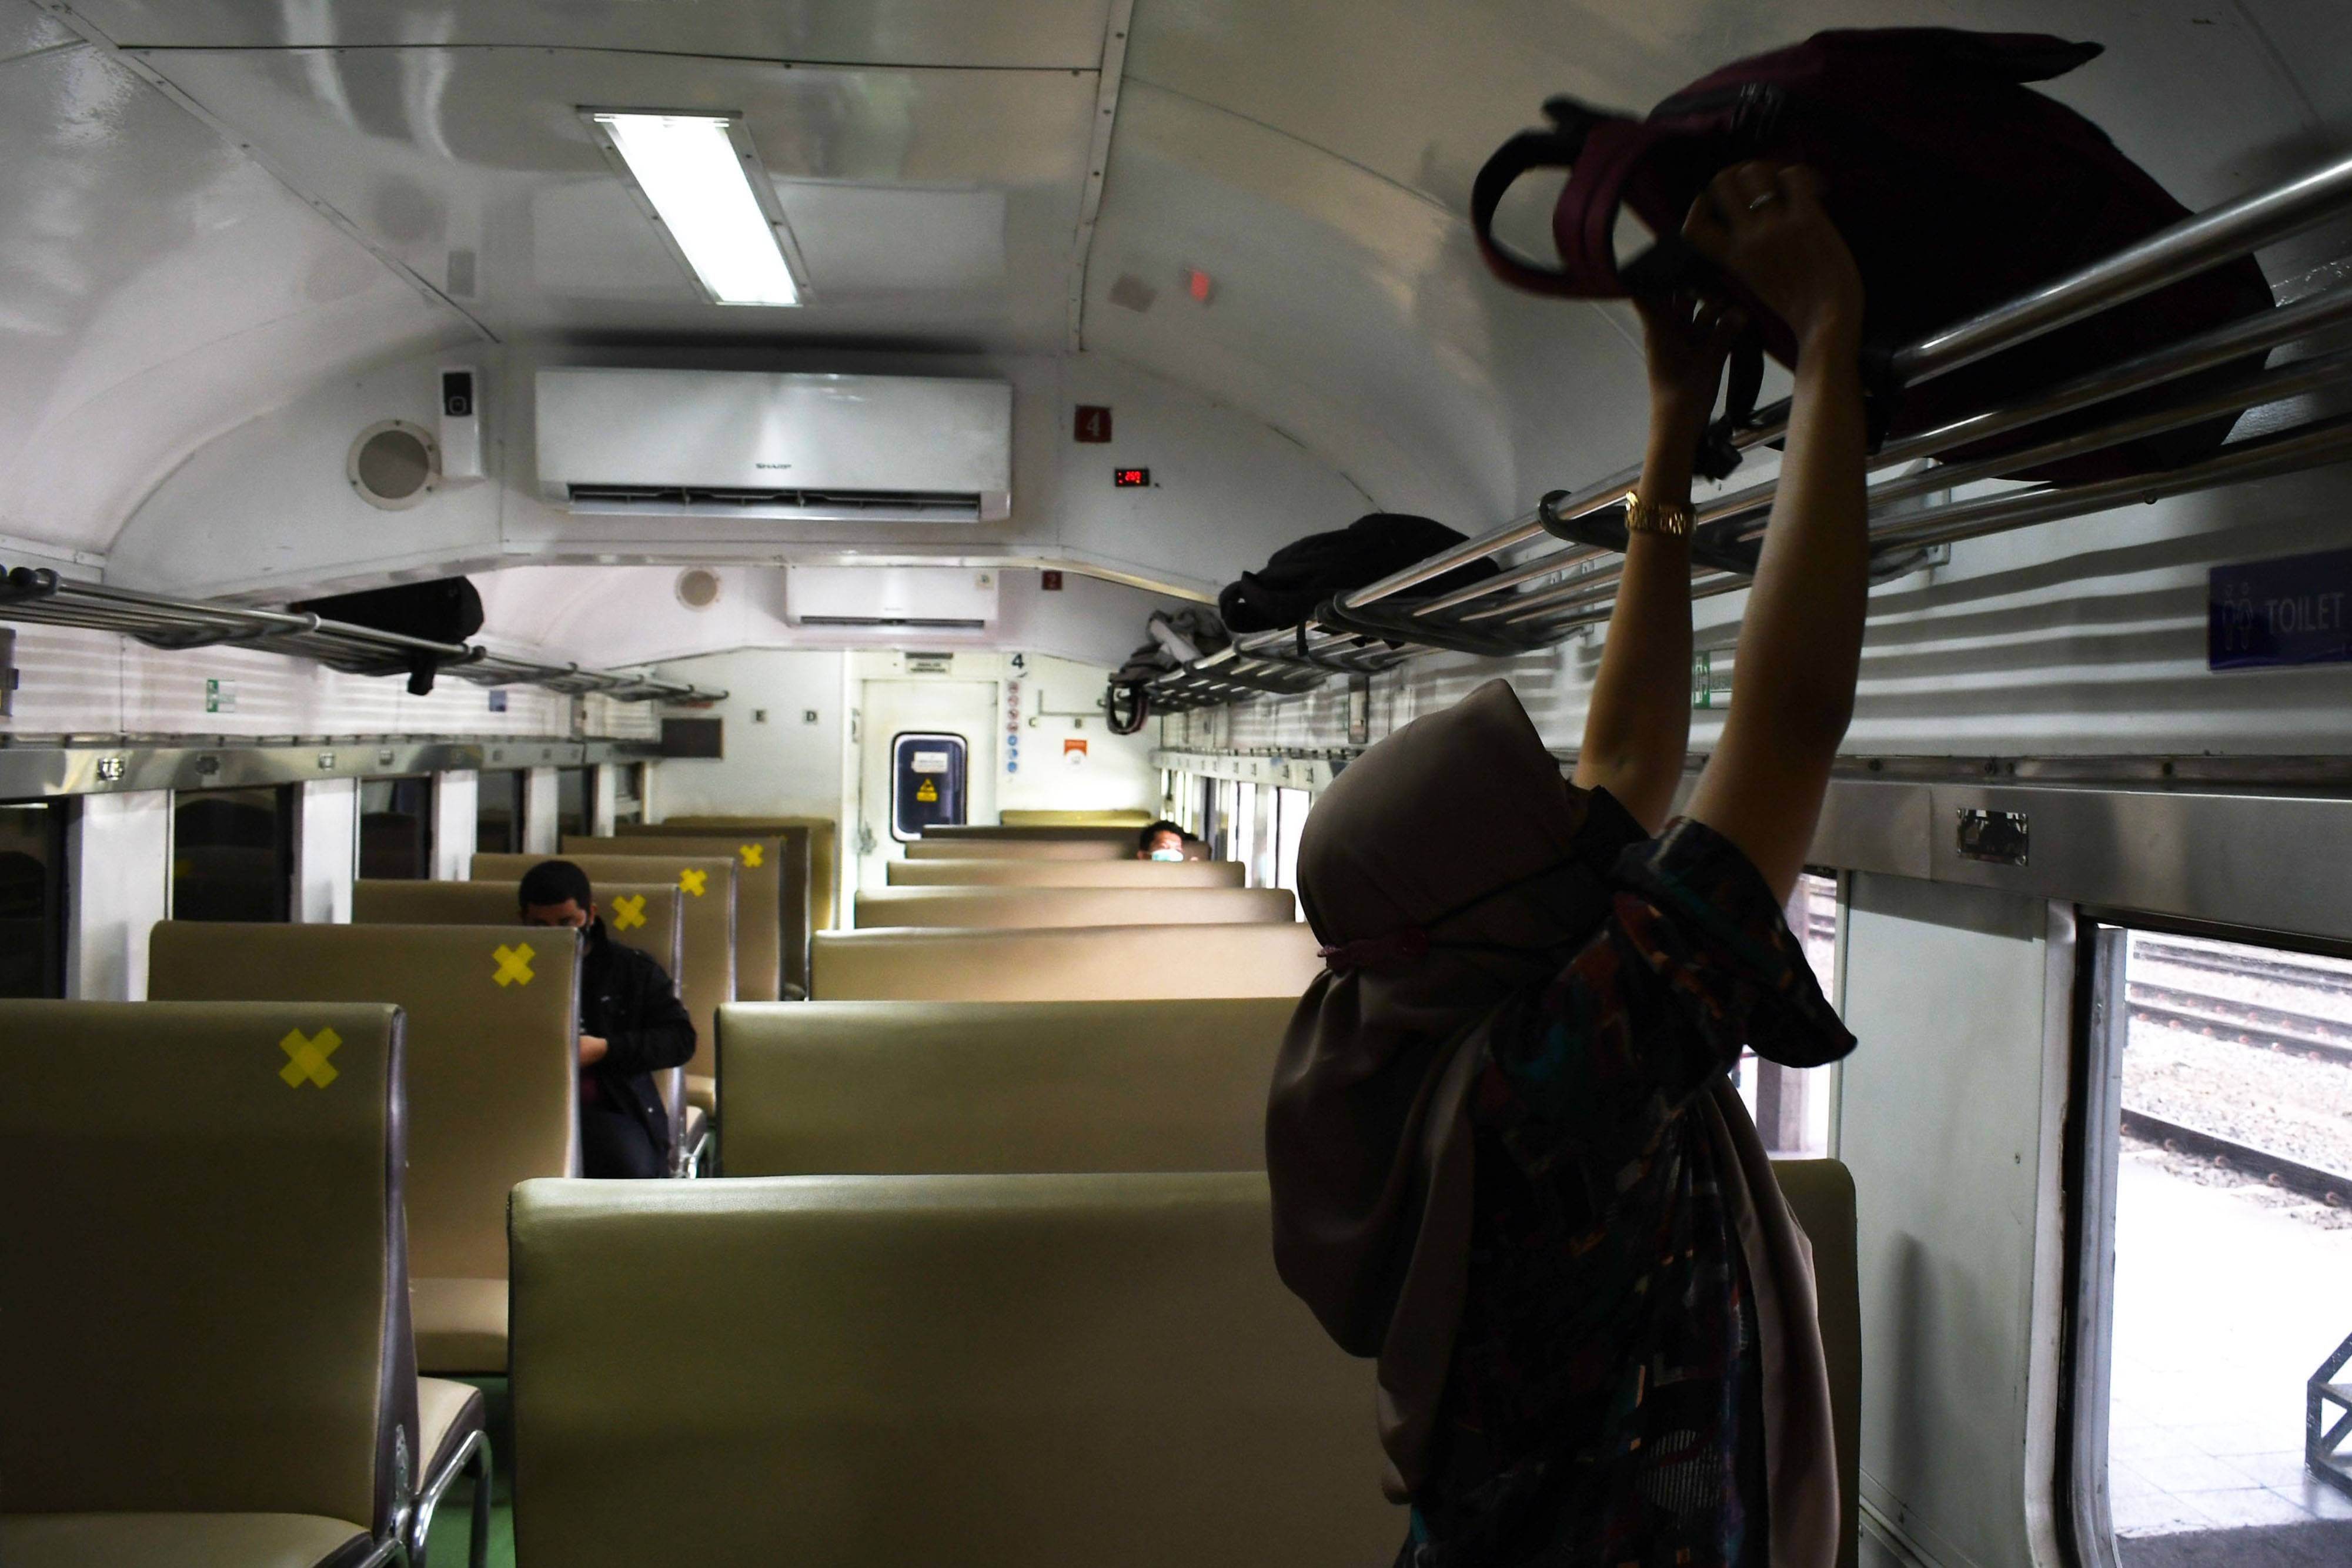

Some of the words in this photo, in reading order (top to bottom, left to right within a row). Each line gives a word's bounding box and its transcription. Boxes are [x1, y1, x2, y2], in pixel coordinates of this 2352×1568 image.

[1086, 410, 1101, 437] 4
[2263, 591, 2346, 634] TOILET
[1011, 653, 1025, 669] 4
[806, 710, 817, 722] D
[1028, 717, 1037, 728] C
